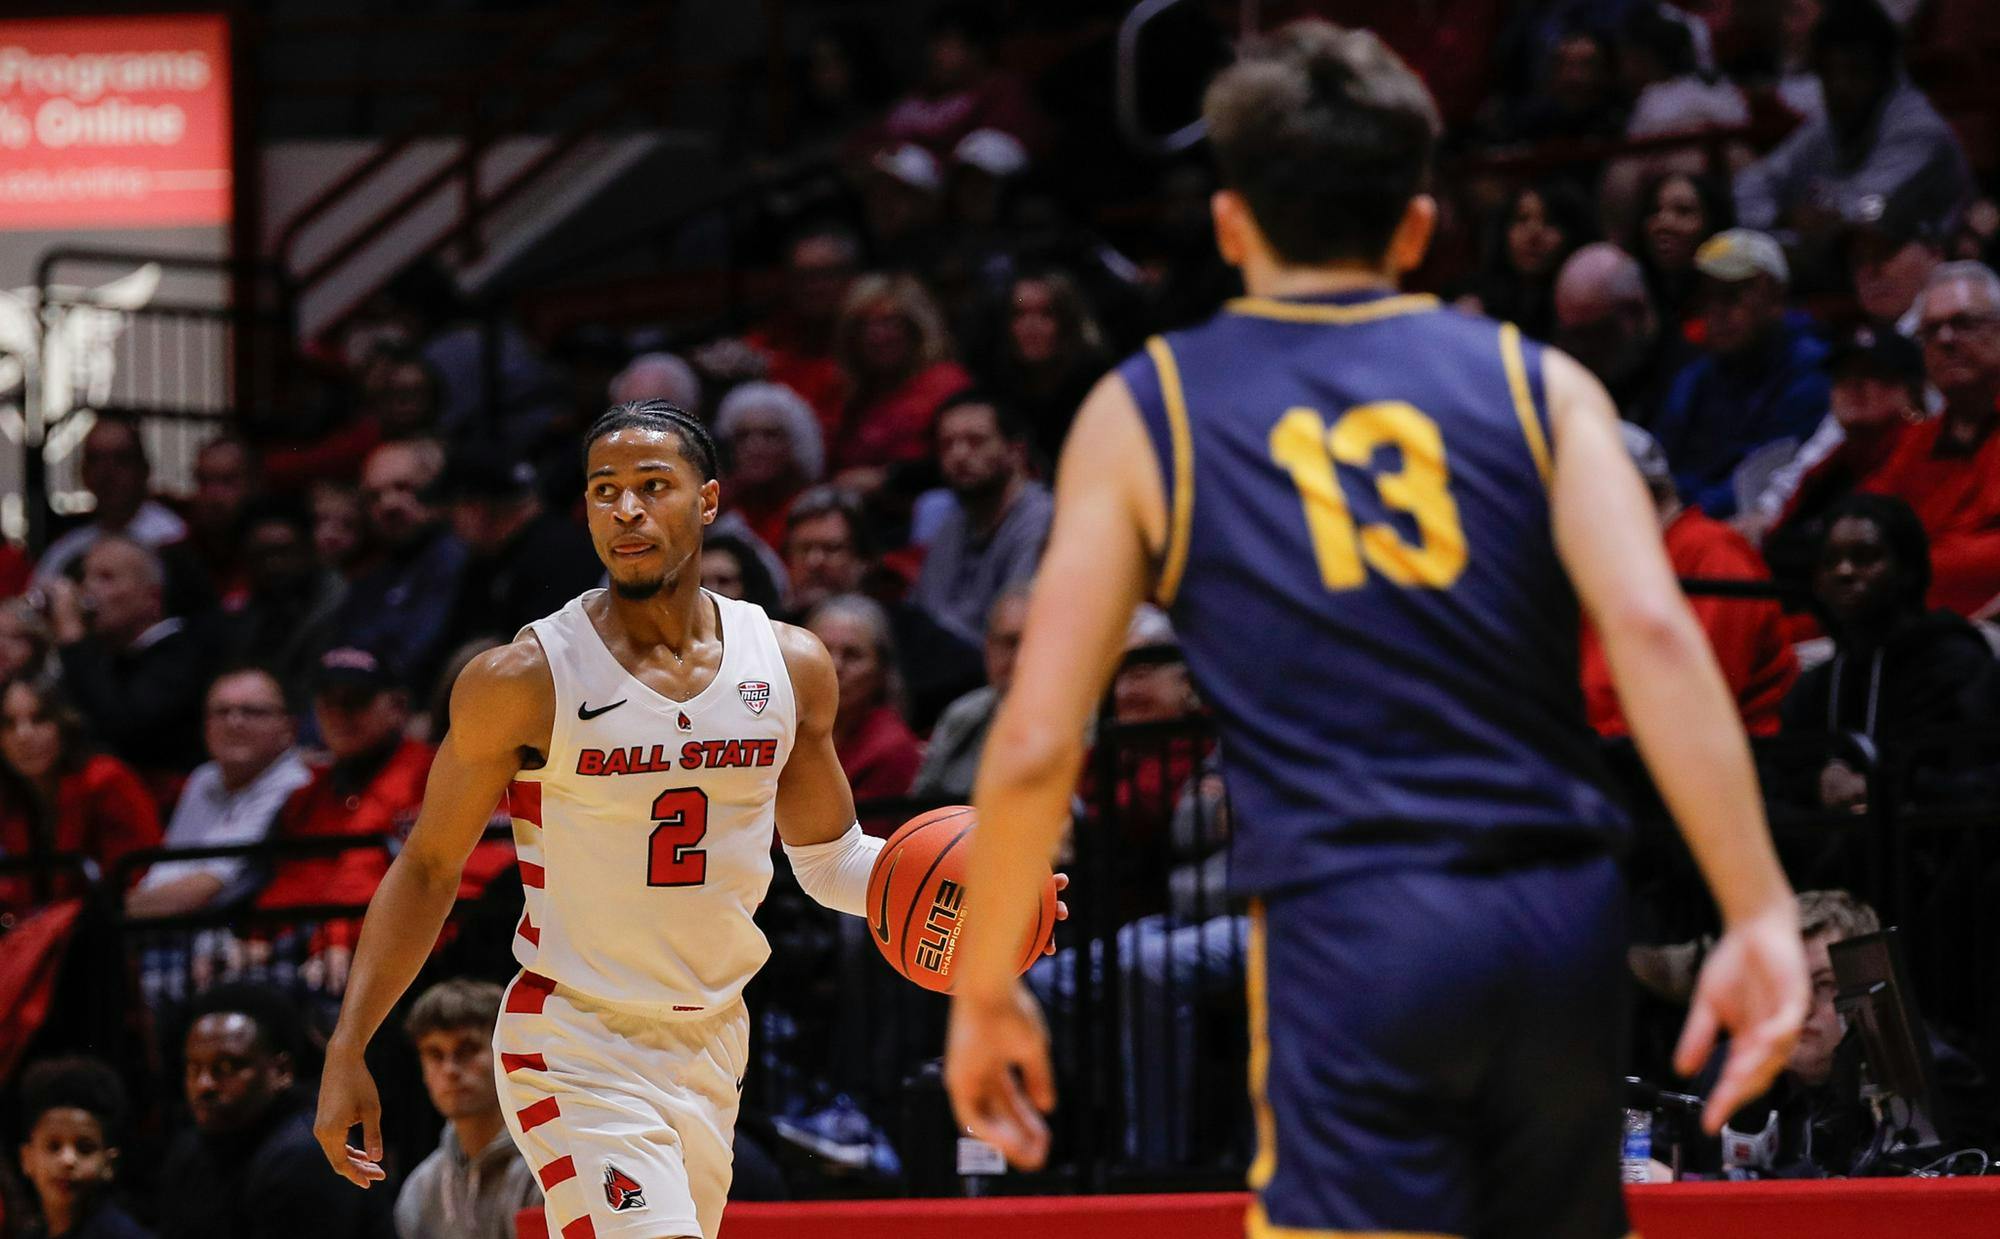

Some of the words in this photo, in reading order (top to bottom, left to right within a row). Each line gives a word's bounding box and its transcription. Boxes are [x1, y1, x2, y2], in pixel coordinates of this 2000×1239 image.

[36, 97, 186, 148] Online
[1269, 400, 1468, 591] 13
[741, 690, 769, 701] MAC
[576, 745, 671, 776] BALL
[679, 739, 777, 769] STATE
[647, 786, 709, 887] 2
[914, 878, 966, 973] ELITE
